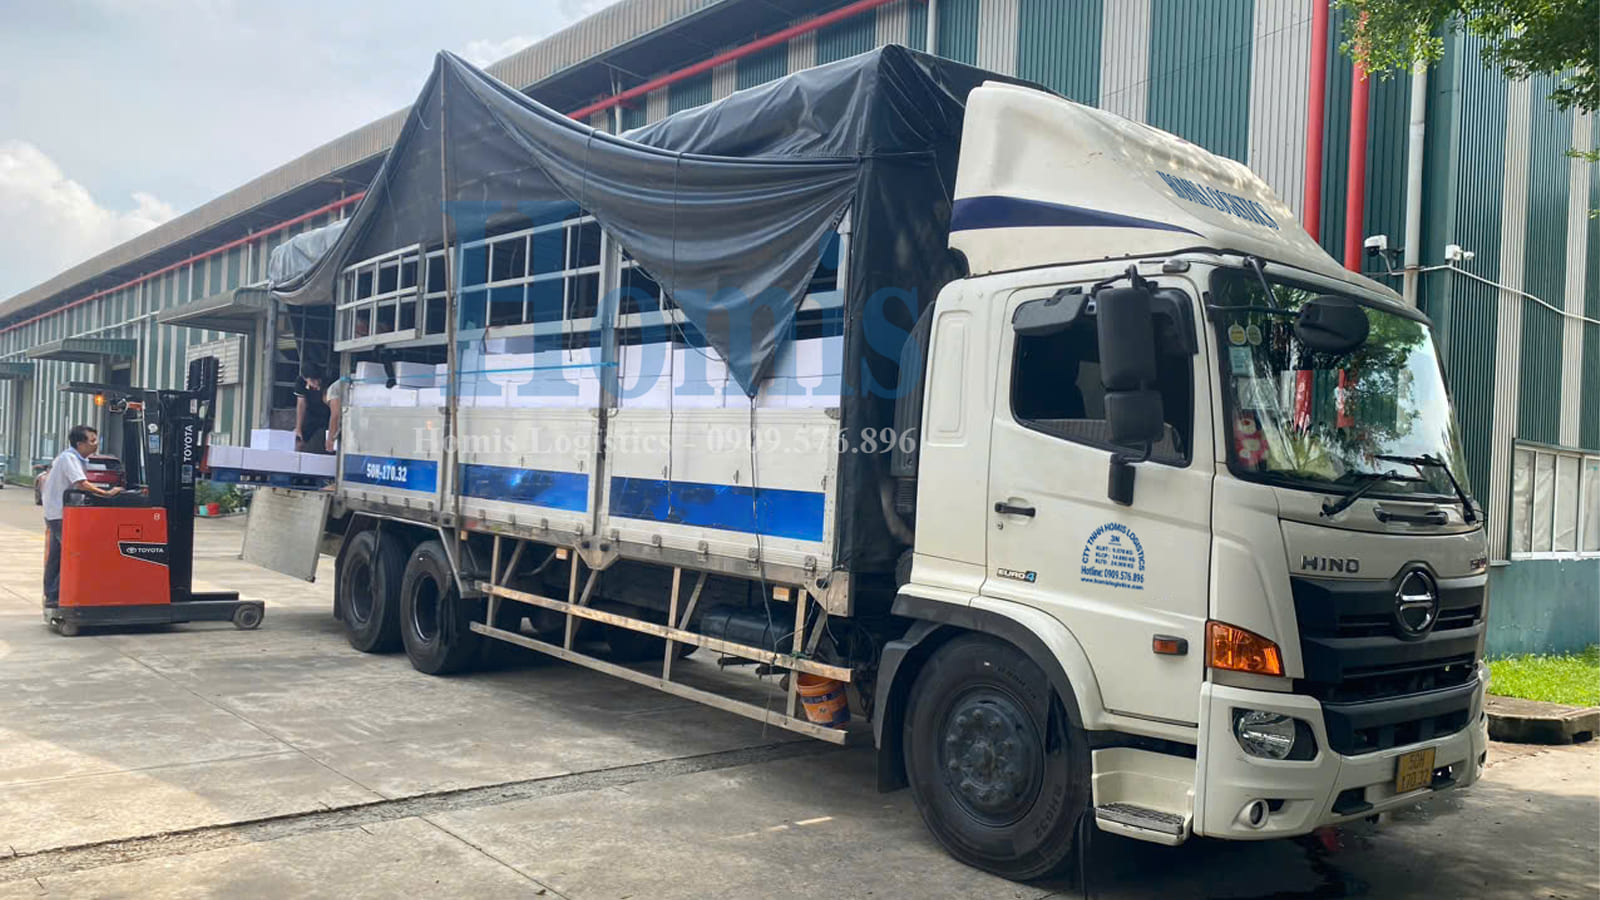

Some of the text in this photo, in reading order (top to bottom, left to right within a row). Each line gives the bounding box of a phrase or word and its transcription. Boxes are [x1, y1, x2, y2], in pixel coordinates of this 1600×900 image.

[1196, 183, 1280, 231] LOGISTICS
[183, 425, 194, 463] TOYOTA
[1081, 522, 1146, 572] CTY TNHH HOMIS LOGISTICS
[1300, 555, 1360, 574] HINO
